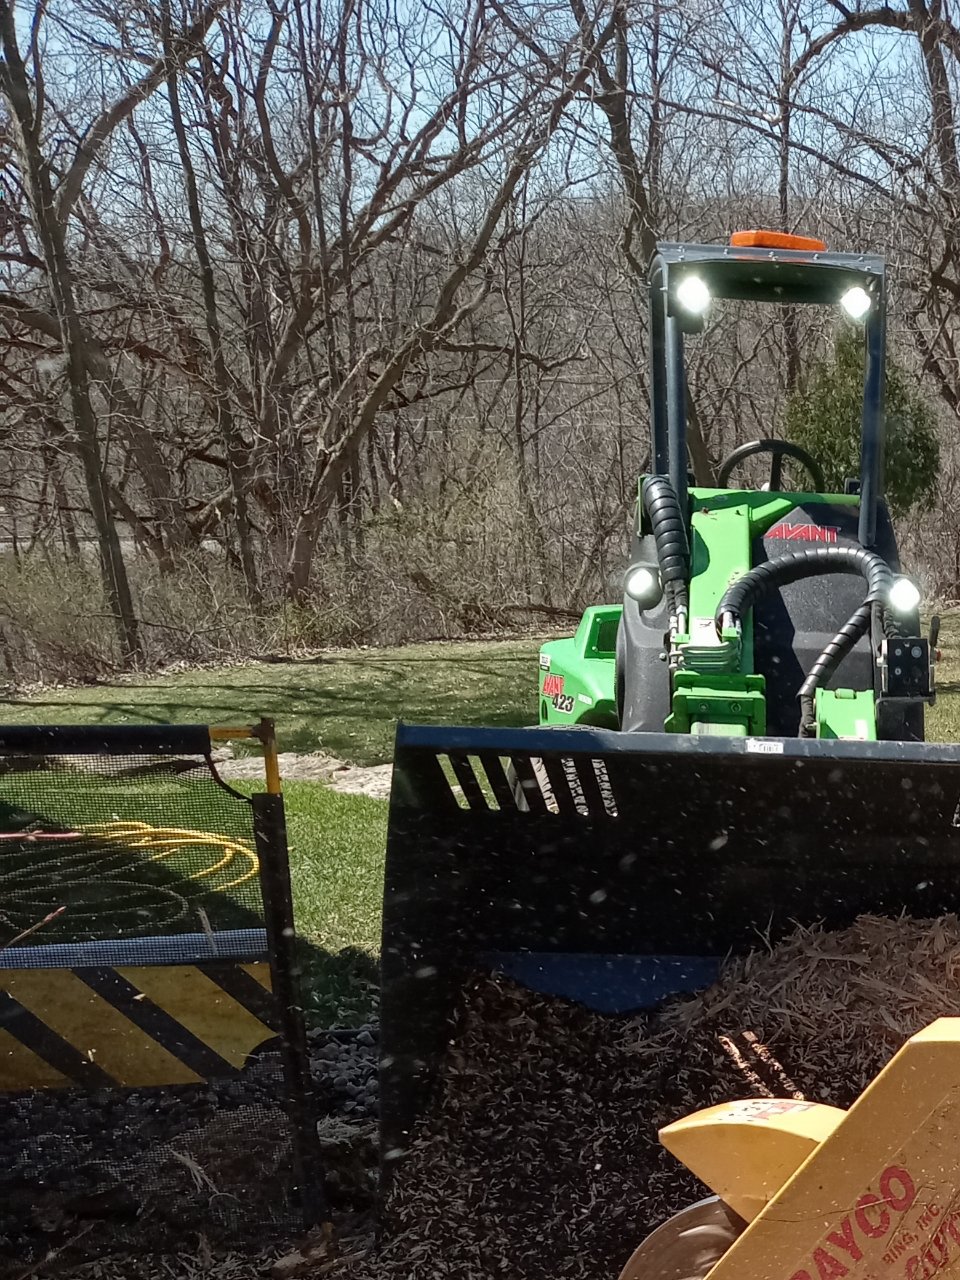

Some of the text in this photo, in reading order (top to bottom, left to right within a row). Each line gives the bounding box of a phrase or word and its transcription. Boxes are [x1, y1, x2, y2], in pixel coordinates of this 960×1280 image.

[763, 522, 840, 544] AVANT
[552, 694, 575, 713] 423
[916, 1203, 945, 1231] INC.
